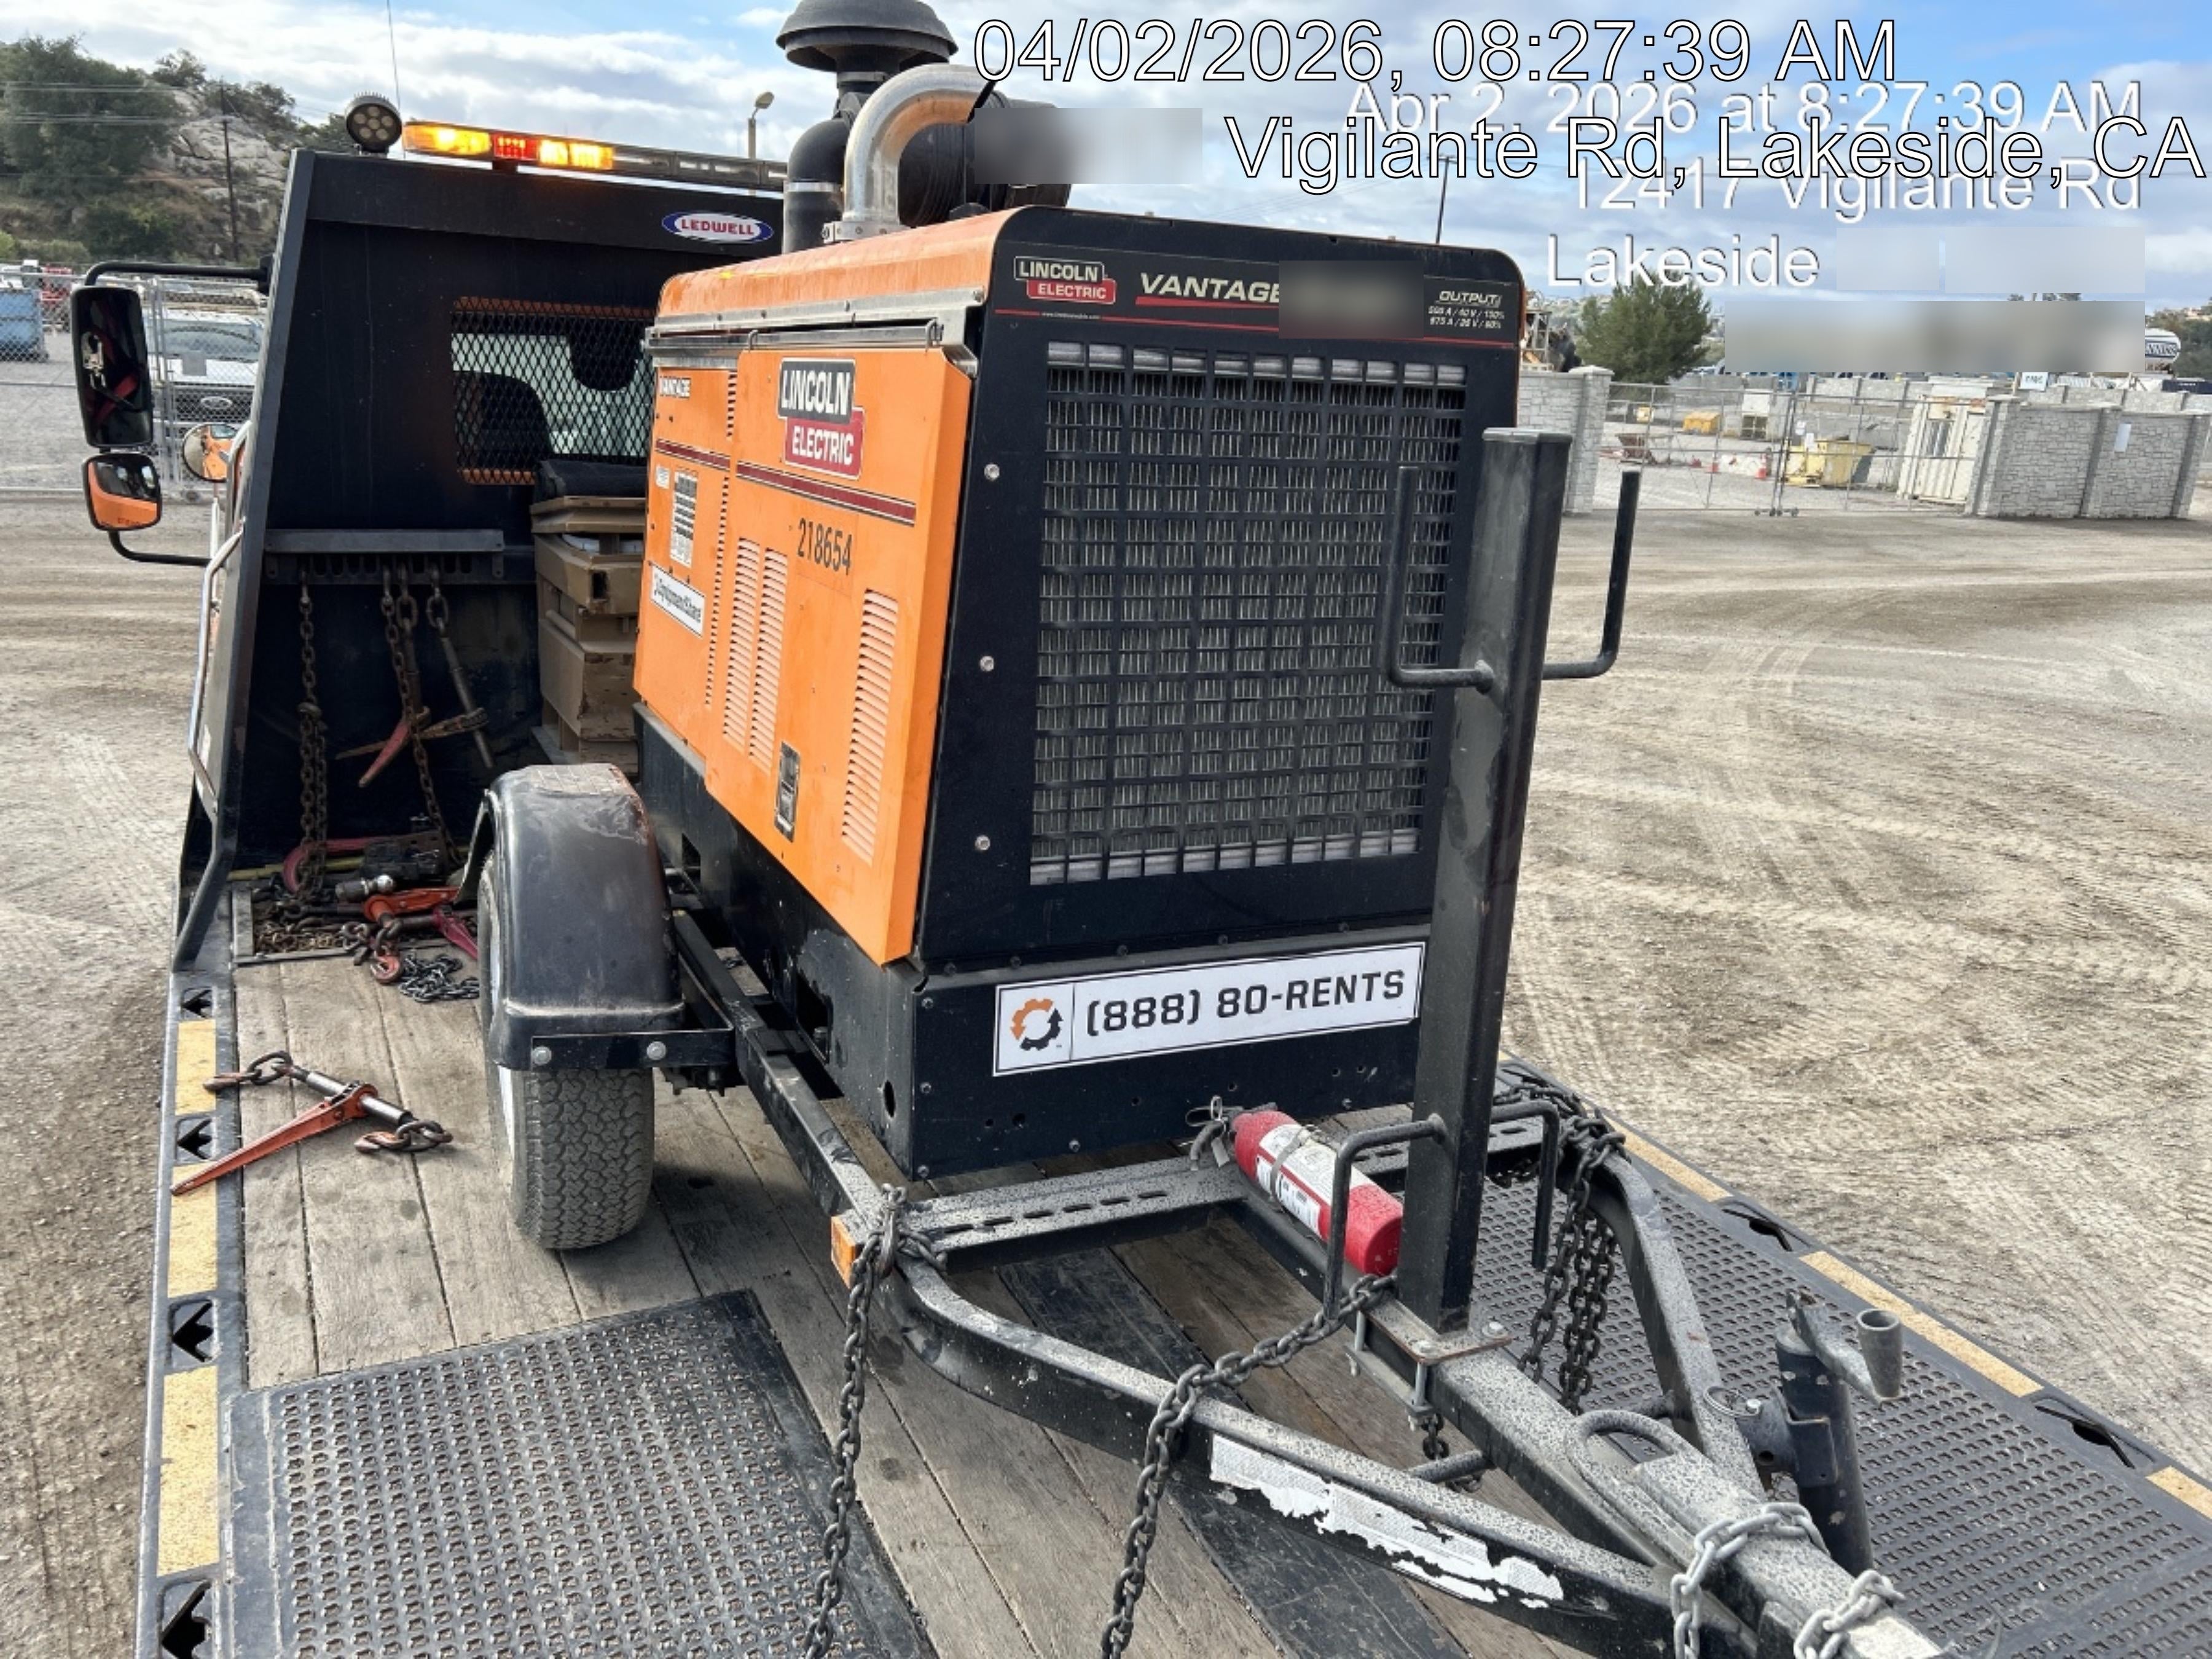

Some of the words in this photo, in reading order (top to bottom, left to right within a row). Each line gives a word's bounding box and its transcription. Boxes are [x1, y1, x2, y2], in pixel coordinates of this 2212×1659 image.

[681, 219, 755, 235] LEDWELL
[1019, 261, 1099, 283] LINCOLN
[1037, 283, 1107, 300] ELECTRIC
[1439, 290, 1499, 305] OUTPUT
[781, 369, 852, 417] LINCOLN
[792, 425, 855, 466] ELECTRIC
[797, 517, 853, 576] 218654
[1086, 989, 1200, 1037] (888)
[1216, 969, 1405, 1019] 80-RENTS
